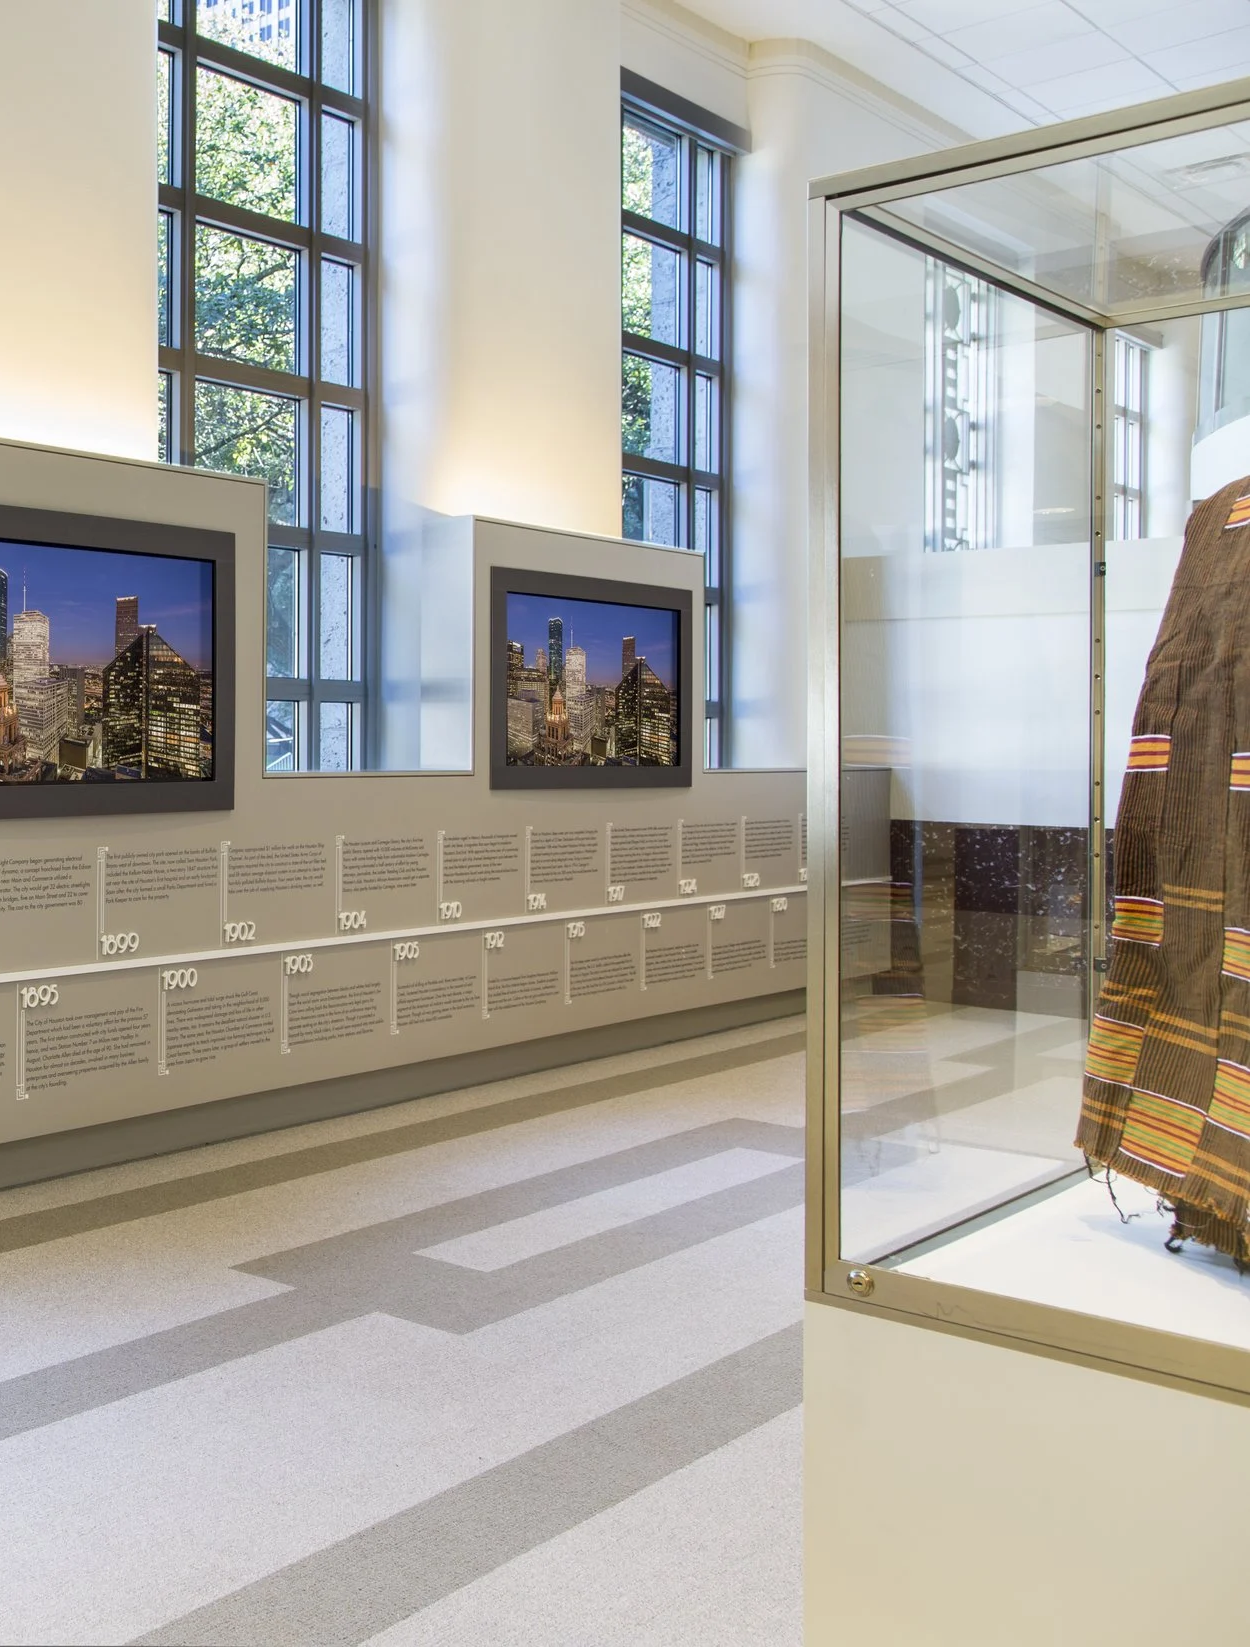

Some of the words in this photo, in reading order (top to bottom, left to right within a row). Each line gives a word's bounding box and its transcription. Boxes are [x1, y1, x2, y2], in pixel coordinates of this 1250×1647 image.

[527, 893, 546, 910] 1914
[608, 885, 625, 901] 1917
[439, 901, 462, 919] 1910
[338, 910, 366, 930] 1904
[567, 921, 585, 938] 1915
[642, 912, 661, 928] 1922
[224, 921, 255, 942] 1902
[485, 931, 504, 949] 1912
[101, 932, 139, 955] 1899
[394, 941, 419, 960] 1905
[284, 953, 313, 974] 1903
[162, 968, 197, 990] 1900
[20, 984, 58, 1008] 1895
